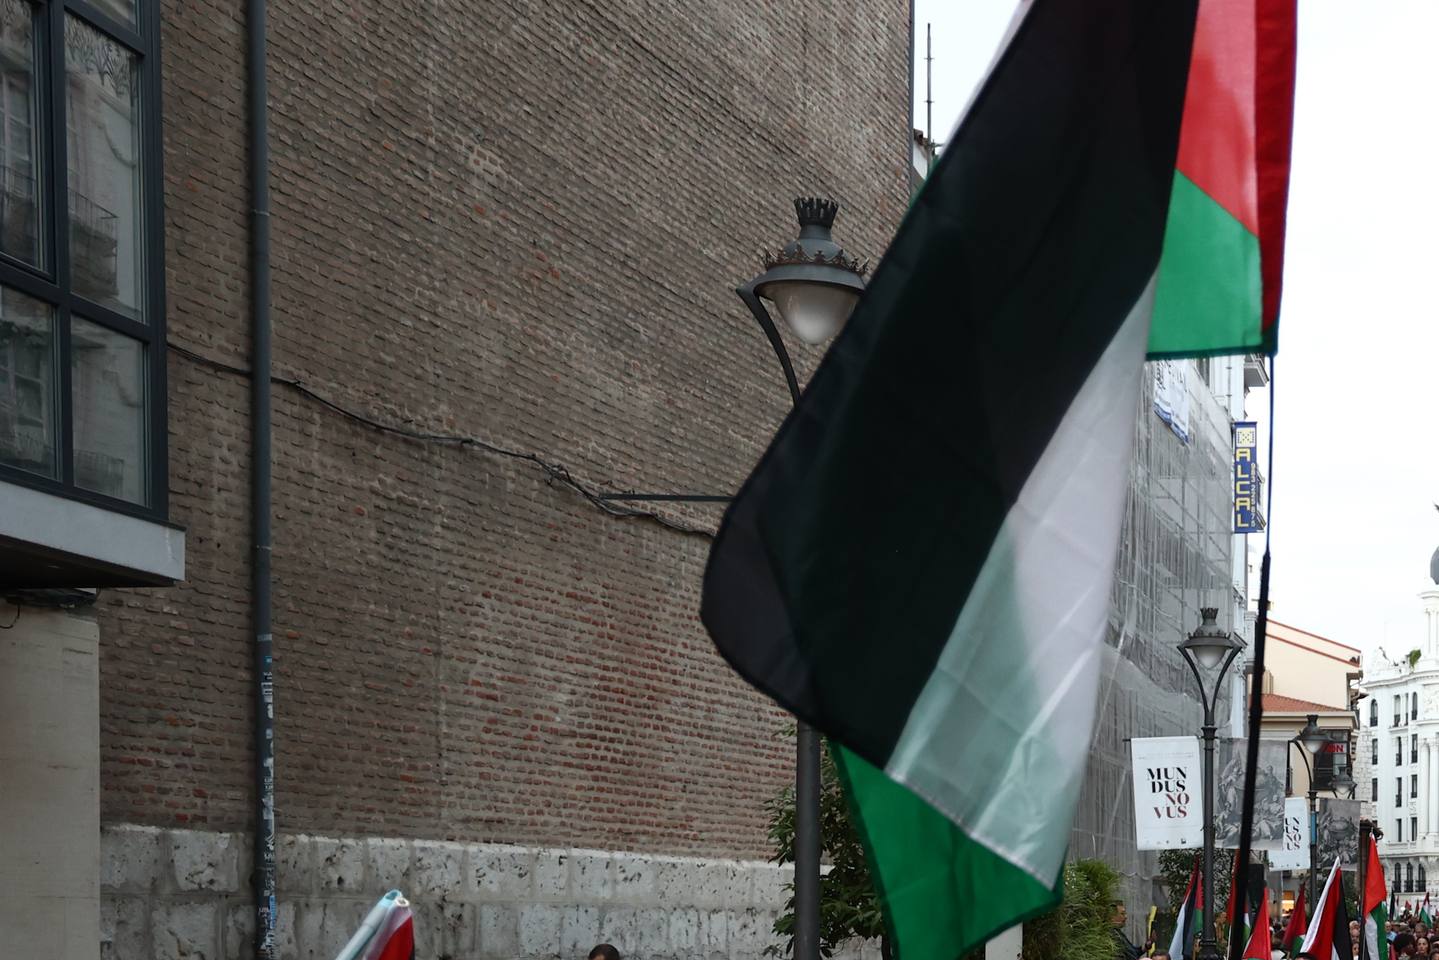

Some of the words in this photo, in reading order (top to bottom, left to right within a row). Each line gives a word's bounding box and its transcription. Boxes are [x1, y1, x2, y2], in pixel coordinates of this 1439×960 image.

[1236, 448, 1250, 527] ALCAL
[1147, 767, 1187, 780] MUN
[1151, 780, 1186, 793] DUS
[1165, 793, 1190, 806] NO
[1153, 806, 1188, 819] VUS
